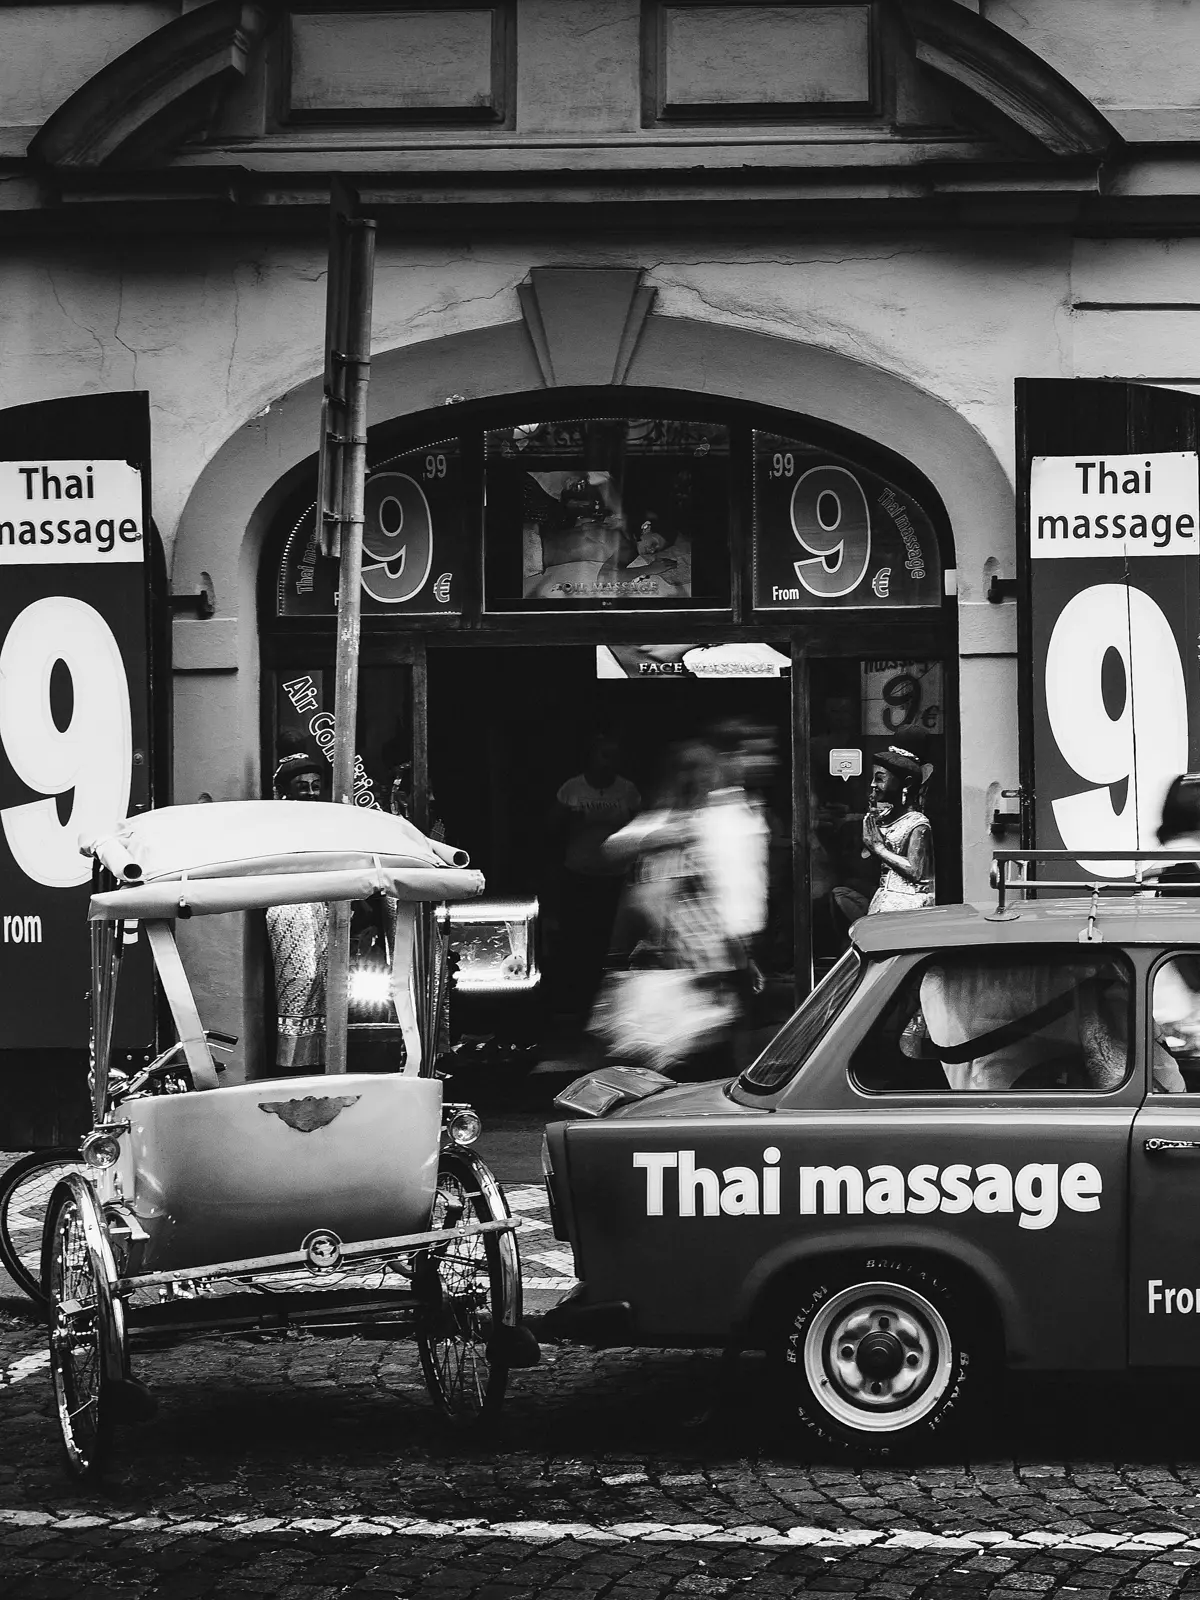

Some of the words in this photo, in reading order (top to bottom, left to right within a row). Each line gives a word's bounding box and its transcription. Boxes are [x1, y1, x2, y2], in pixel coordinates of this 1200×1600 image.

[18, 465, 94, 500] Thai
[1075, 460, 1152, 495] Thai
[361, 471, 434, 604] 9
[790, 465, 871, 598] 9
[877, 487, 904, 519] Thai
[895, 513, 927, 580] massage
[1037, 504, 1195, 550] massage
[296, 564, 315, 596] Thai
[433, 572, 453, 603] €
[772, 585, 800, 602] From
[872, 567, 891, 599] €
[639, 662, 683, 673] FACE
[282, 675, 318, 714] Air
[882, 674, 922, 733] 9
[921, 705, 940, 729] €
[0, 597, 133, 888] 9
[1045, 583, 1189, 879] 9
[3, 915, 43, 944] rom
[633, 1147, 781, 1217] Thai
[800, 1162, 1103, 1230] massage
